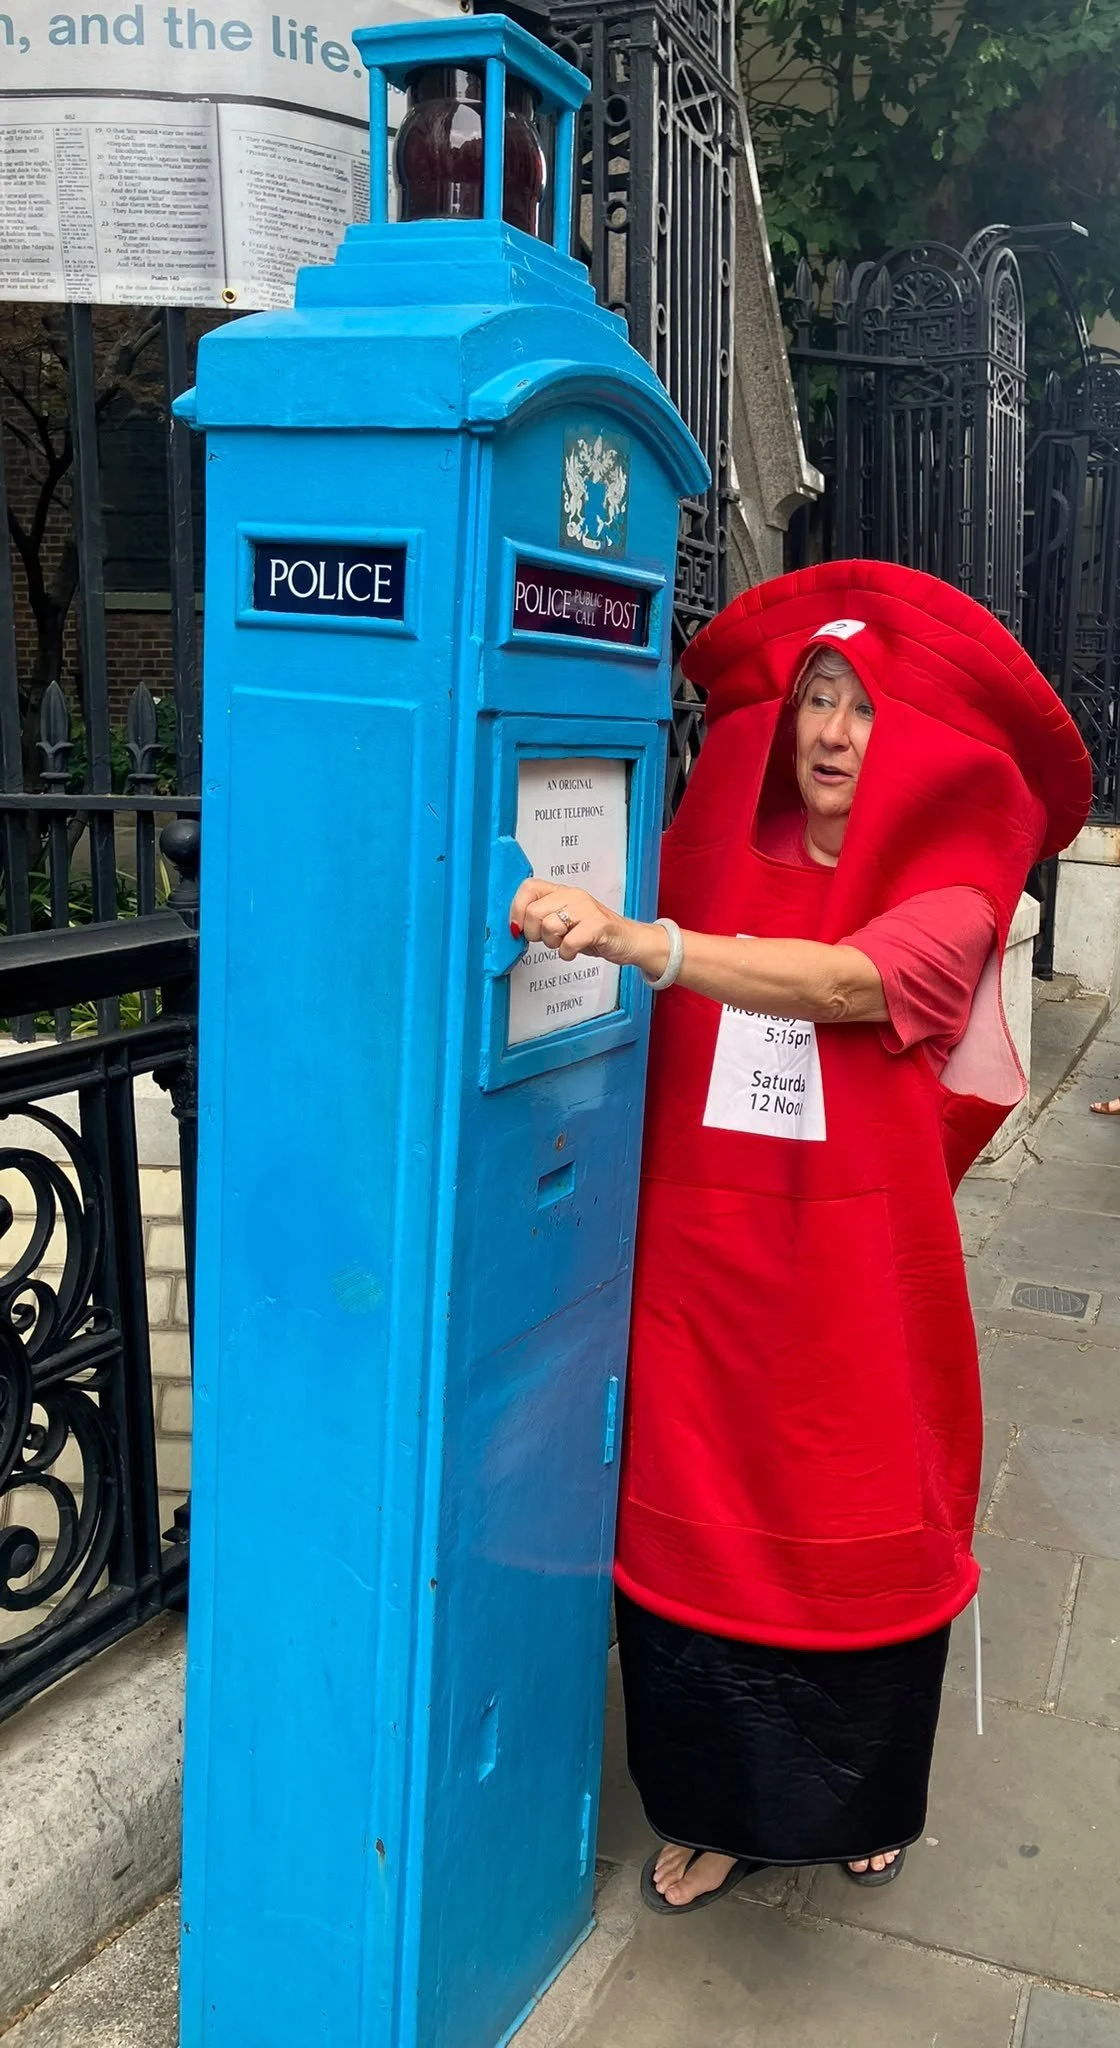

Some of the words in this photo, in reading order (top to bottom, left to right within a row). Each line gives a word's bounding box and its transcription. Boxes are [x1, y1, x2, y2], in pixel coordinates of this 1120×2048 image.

[49, 5, 144, 45] and
[164, 7, 251, 51] the
[272, 15, 362, 78] life.
[269, 558, 393, 604] POLICE
[515, 581, 571, 619] POLICE
[574, 589, 604, 608] PUBLIC
[575, 610, 597, 627] CALL
[604, 598, 640, 630] POST
[824, 623, 848, 633] 2
[546, 780, 558, 791] AN
[559, 779, 594, 791] ORIGINAL
[535, 808, 562, 821] POLICE
[564, 806, 605, 819] TELEPHONE
[560, 835, 579, 847] FREE
[550, 865, 565, 877] FOR
[567, 863, 580, 875] USE
[581, 862, 591, 873] OF
[529, 976, 557, 993] PLEASE
[558, 971, 573, 986] USE
[573, 966, 600, 982] NEARBY
[546, 996, 584, 1015] PAYPHONE
[750, 1093, 770, 1112] 12
